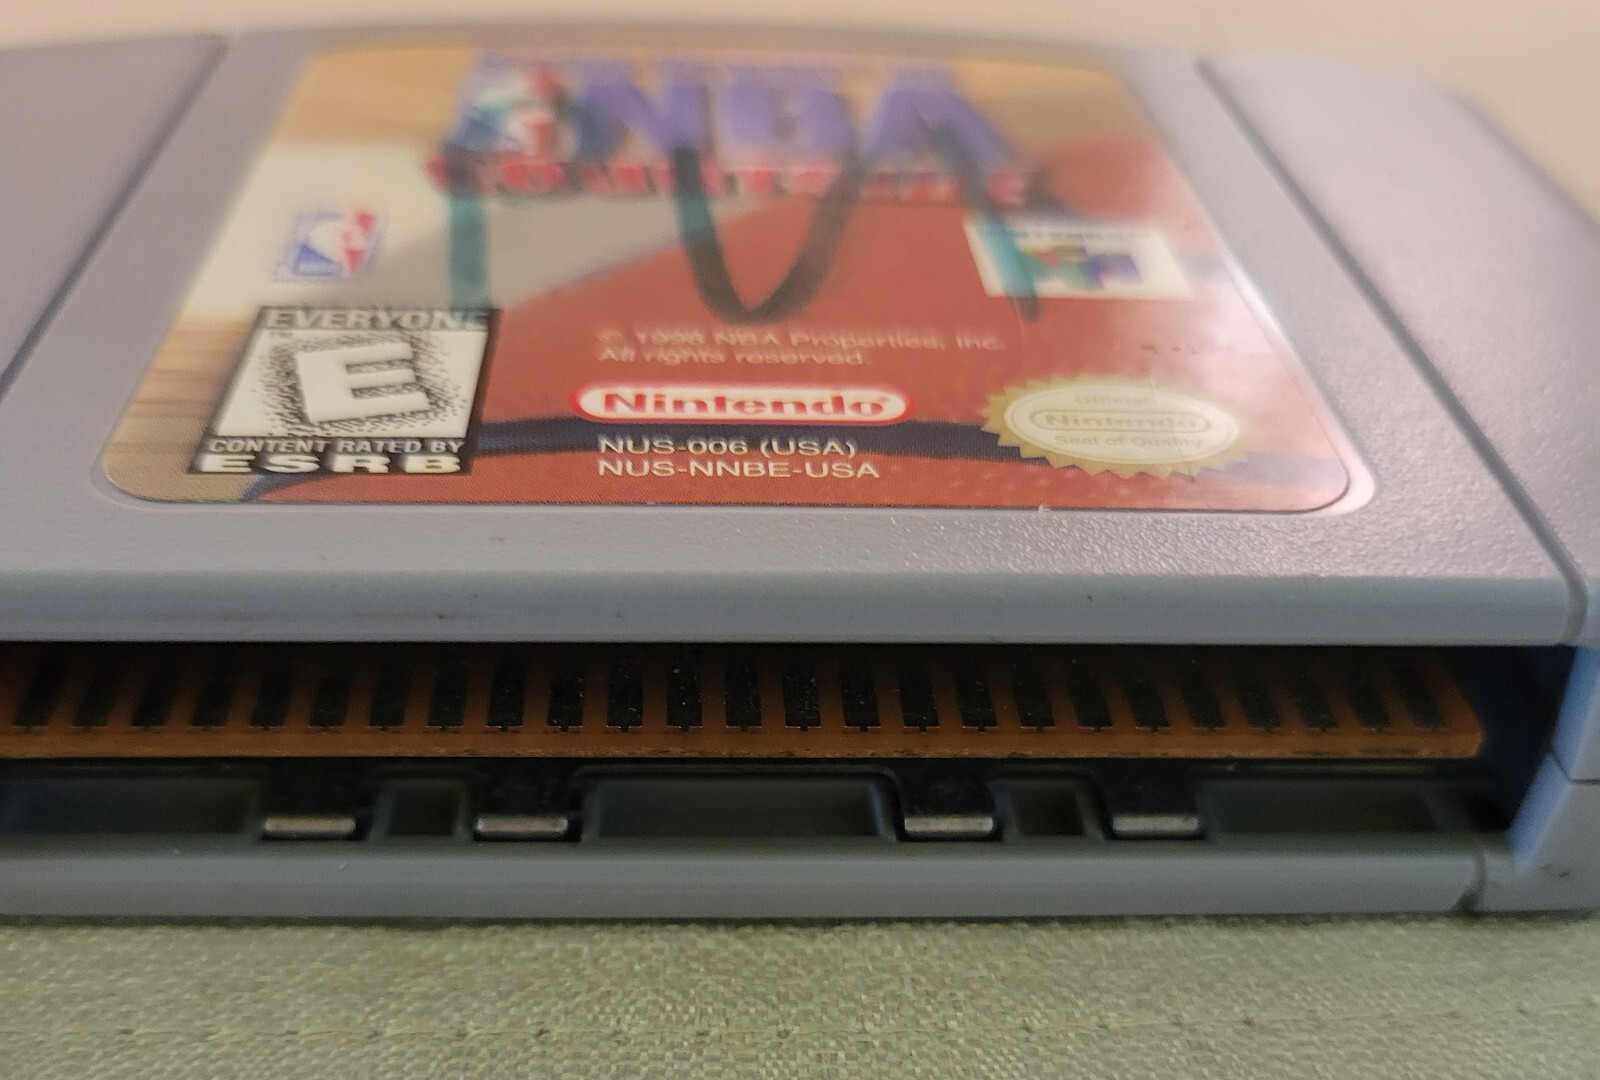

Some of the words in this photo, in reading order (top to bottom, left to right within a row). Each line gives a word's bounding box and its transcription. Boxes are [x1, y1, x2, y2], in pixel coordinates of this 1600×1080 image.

[263, 309, 489, 330] EVERYONE
[714, 332, 780, 346] NBA
[598, 347, 636, 363] All
[643, 348, 726, 366] rights
[1044, 412, 1201, 430] Nintendo
[208, 439, 330, 454] CONTENT
[335, 439, 424, 454] RATED
[429, 440, 466, 455] BY
[599, 436, 748, 456] NUS-006
[760, 438, 857, 458] (USA)
[1054, 435, 1100, 447] Seal
[1105, 435, 1129, 447] of
[598, 459, 880, 480] NUS-NNBE-USA
